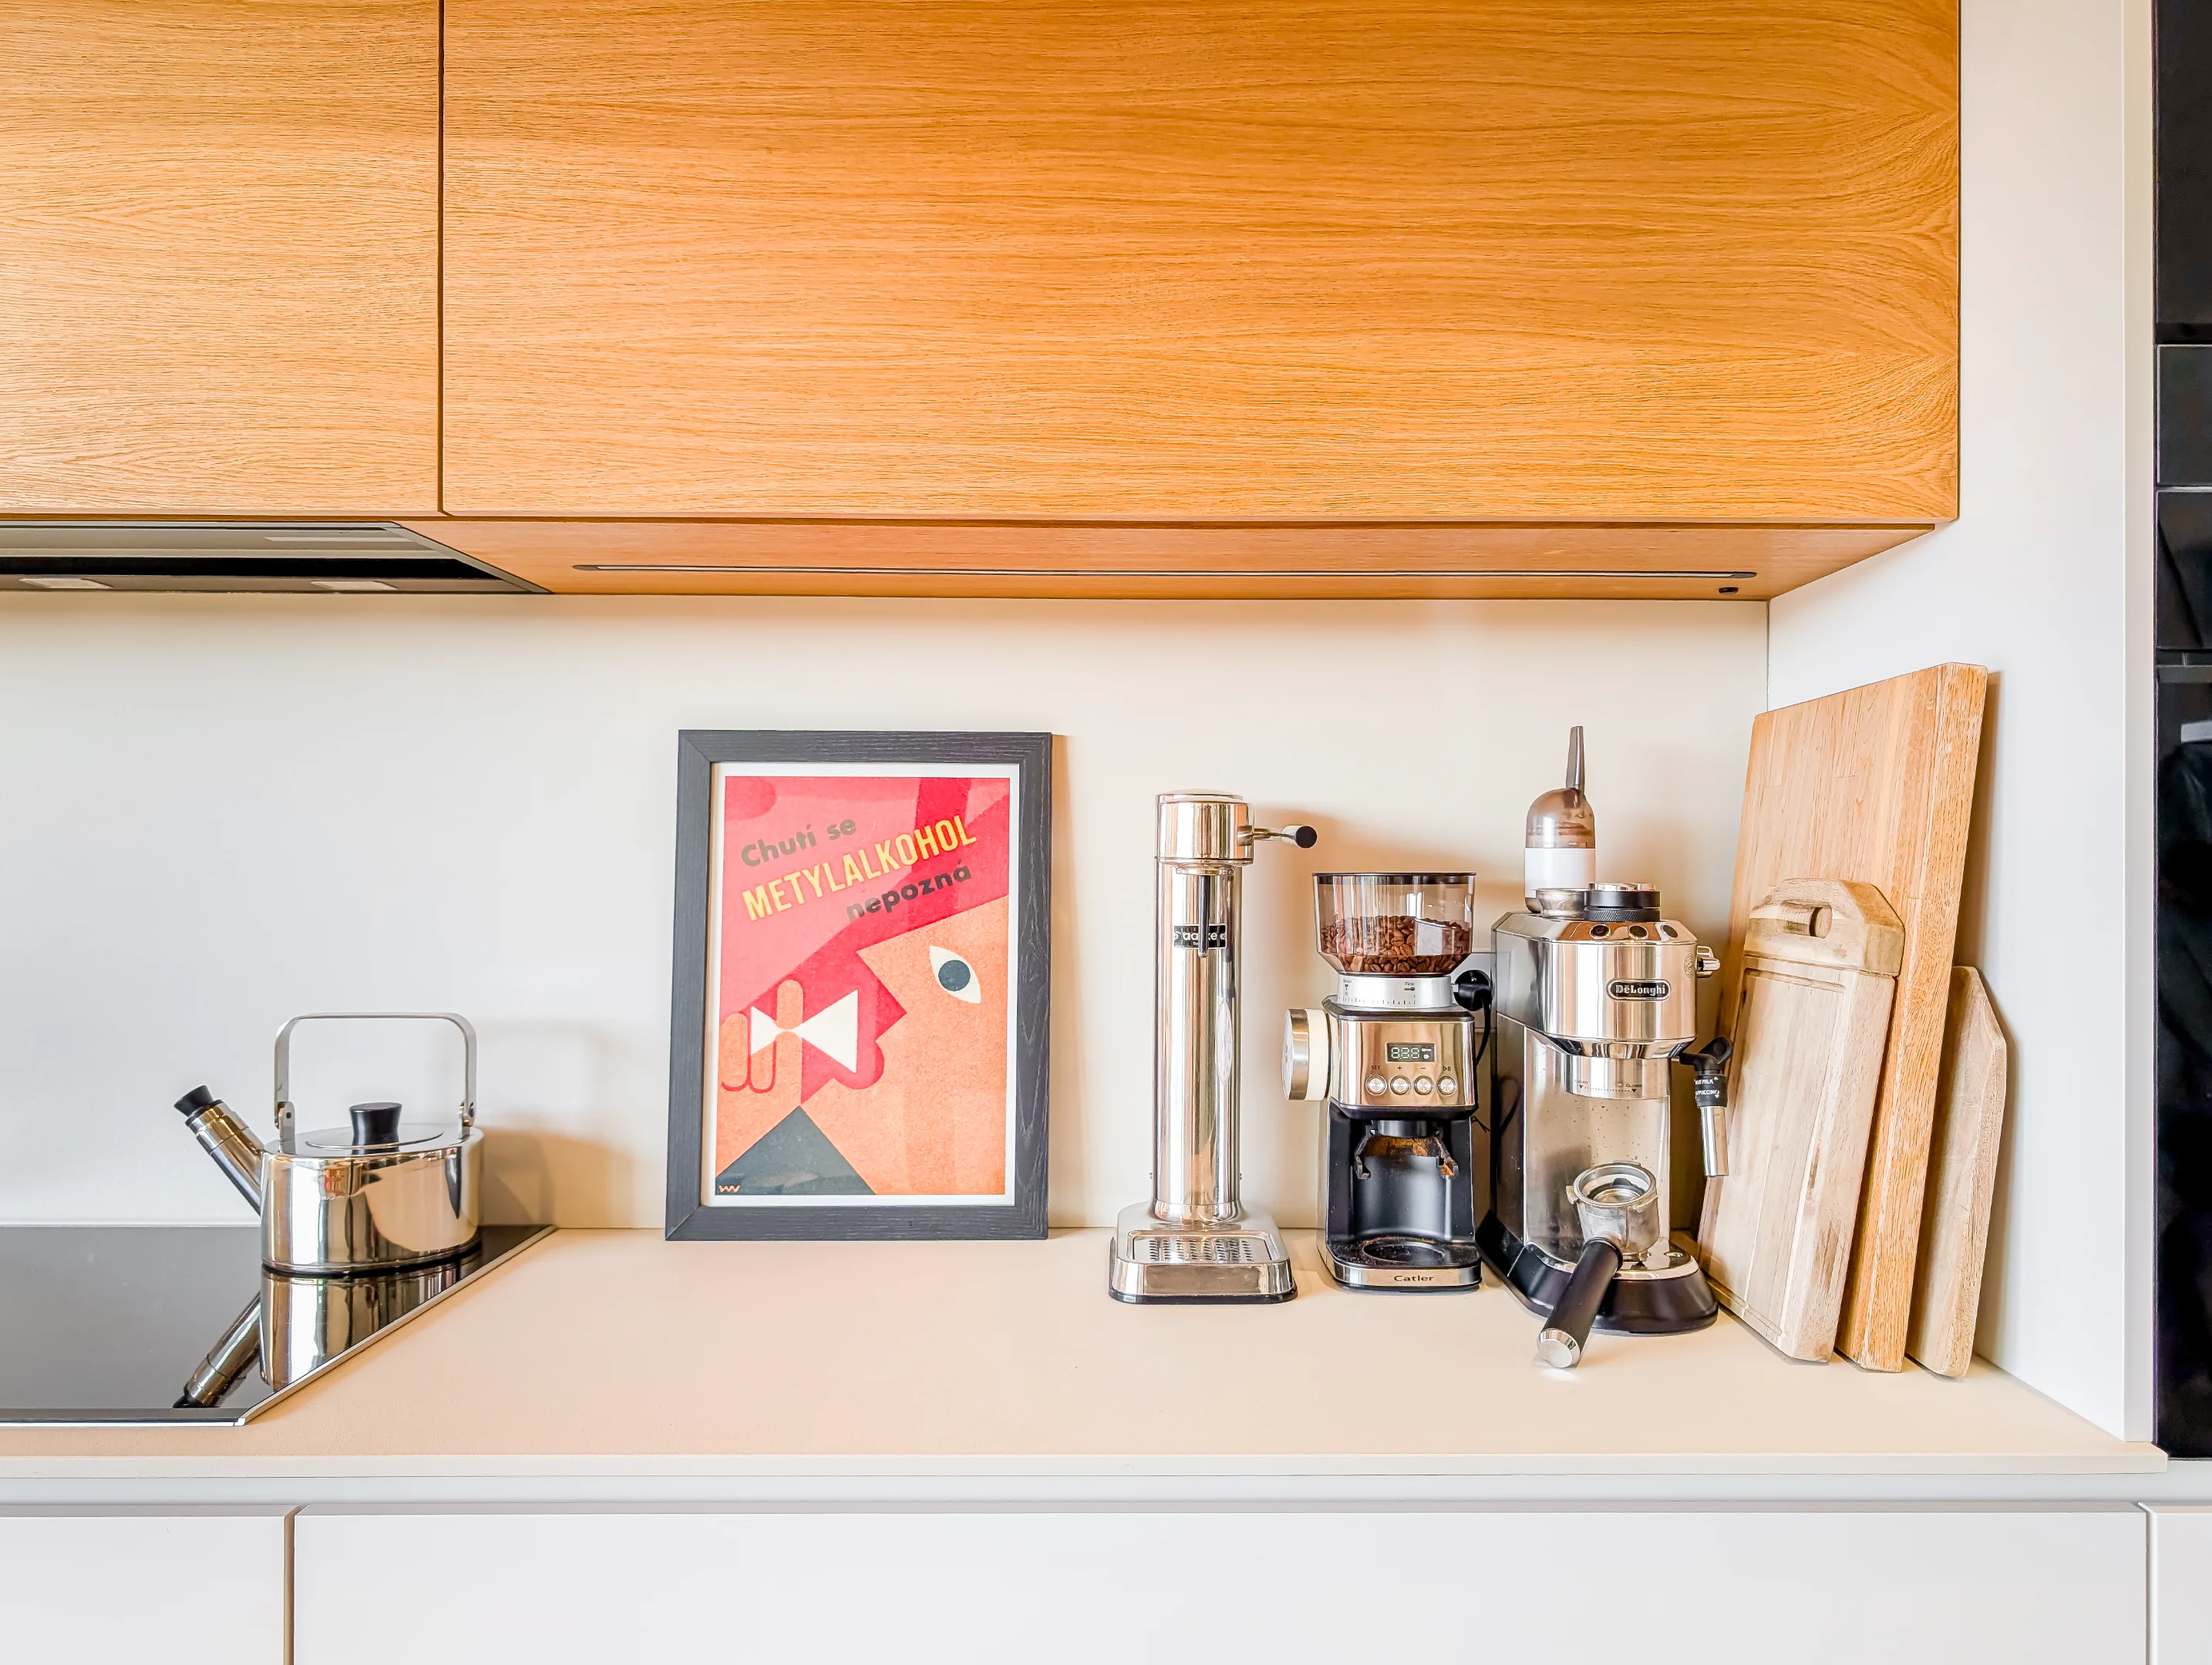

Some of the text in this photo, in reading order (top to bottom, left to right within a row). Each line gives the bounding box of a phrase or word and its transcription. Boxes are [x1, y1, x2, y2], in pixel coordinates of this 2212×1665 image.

[741, 819, 857, 867] Chutí se
[742, 815, 977, 921] METYLALKOHOL
[846, 858, 971, 921] nepozná
[1183, 931, 1218, 941] aae
